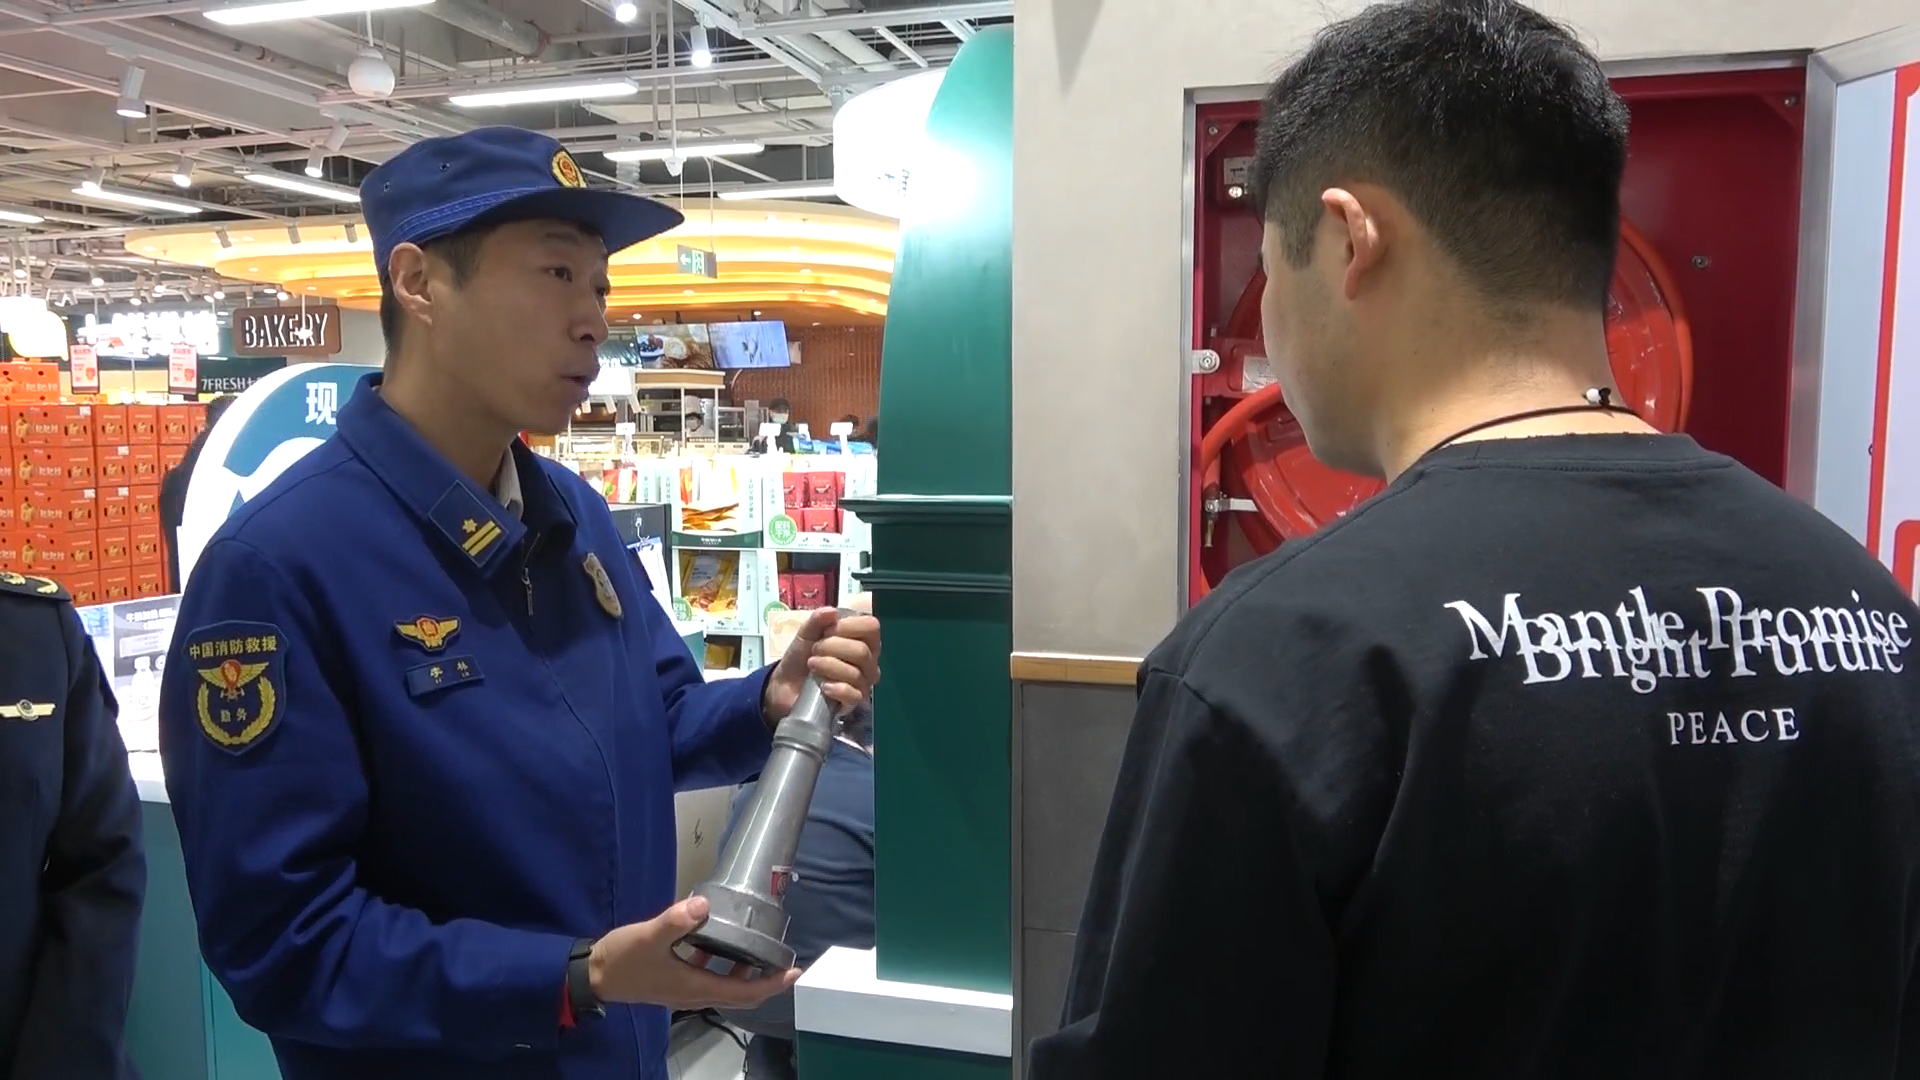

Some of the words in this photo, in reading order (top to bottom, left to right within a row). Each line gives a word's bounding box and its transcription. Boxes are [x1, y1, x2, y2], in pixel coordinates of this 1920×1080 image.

[243, 313, 328, 348] BAKERY
[305, 381, 338, 426] 现
[1444, 586, 1686, 660] Mantle
[1696, 586, 1912, 654] Promise
[189, 635, 277, 660] 中国消防救援
[1518, 614, 1712, 694] Bright
[1722, 613, 1905, 677] Future
[1667, 707, 1800, 745] PEACE
